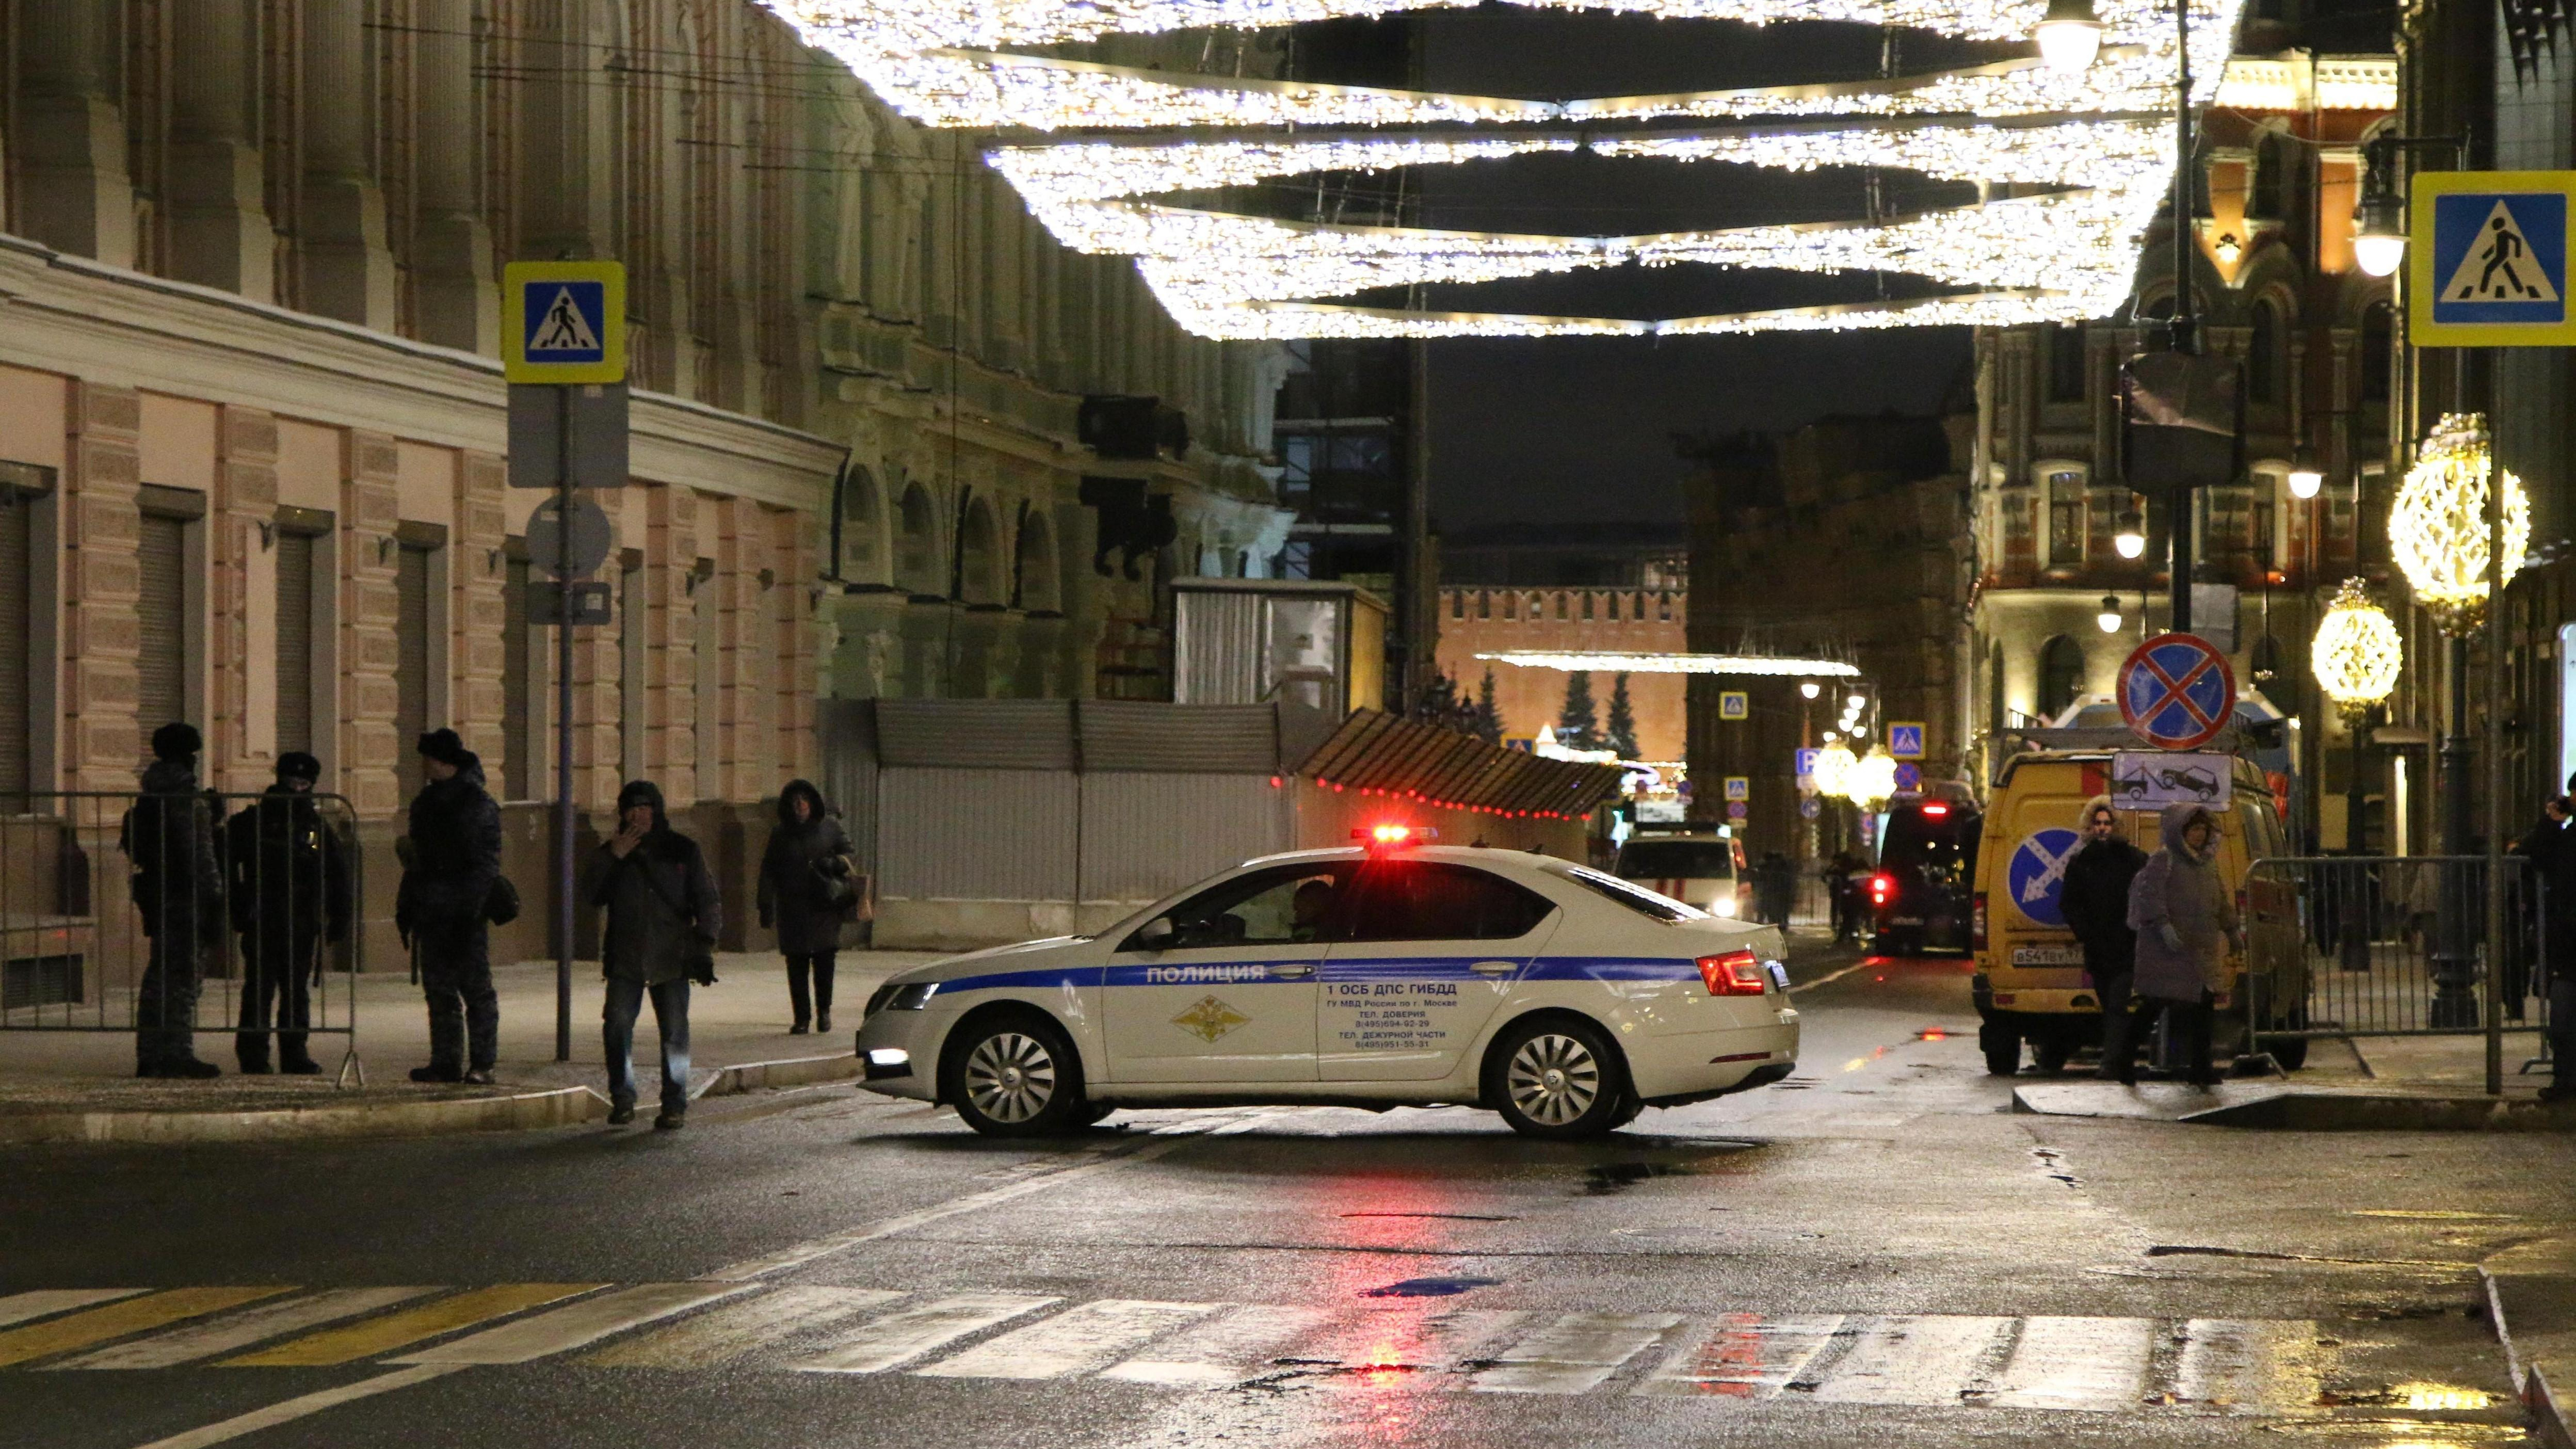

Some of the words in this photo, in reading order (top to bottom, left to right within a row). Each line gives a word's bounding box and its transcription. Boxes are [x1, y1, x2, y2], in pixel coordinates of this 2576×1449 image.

[1147, 964, 1264, 983] ПОЛИЦИЯ
[1327, 985, 1333, 995] 1
[1340, 985, 1369, 995] ОСБ
[1374, 984, 1404, 996] ДПС
[1409, 984, 1457, 995] ГИБДД
[1424, 999, 1458, 1007] Москве
[1382, 1011, 1426, 1019] ДОВЕРИЯ
[1362, 1030, 1413, 1039] ДЕЖУРНОЙ
